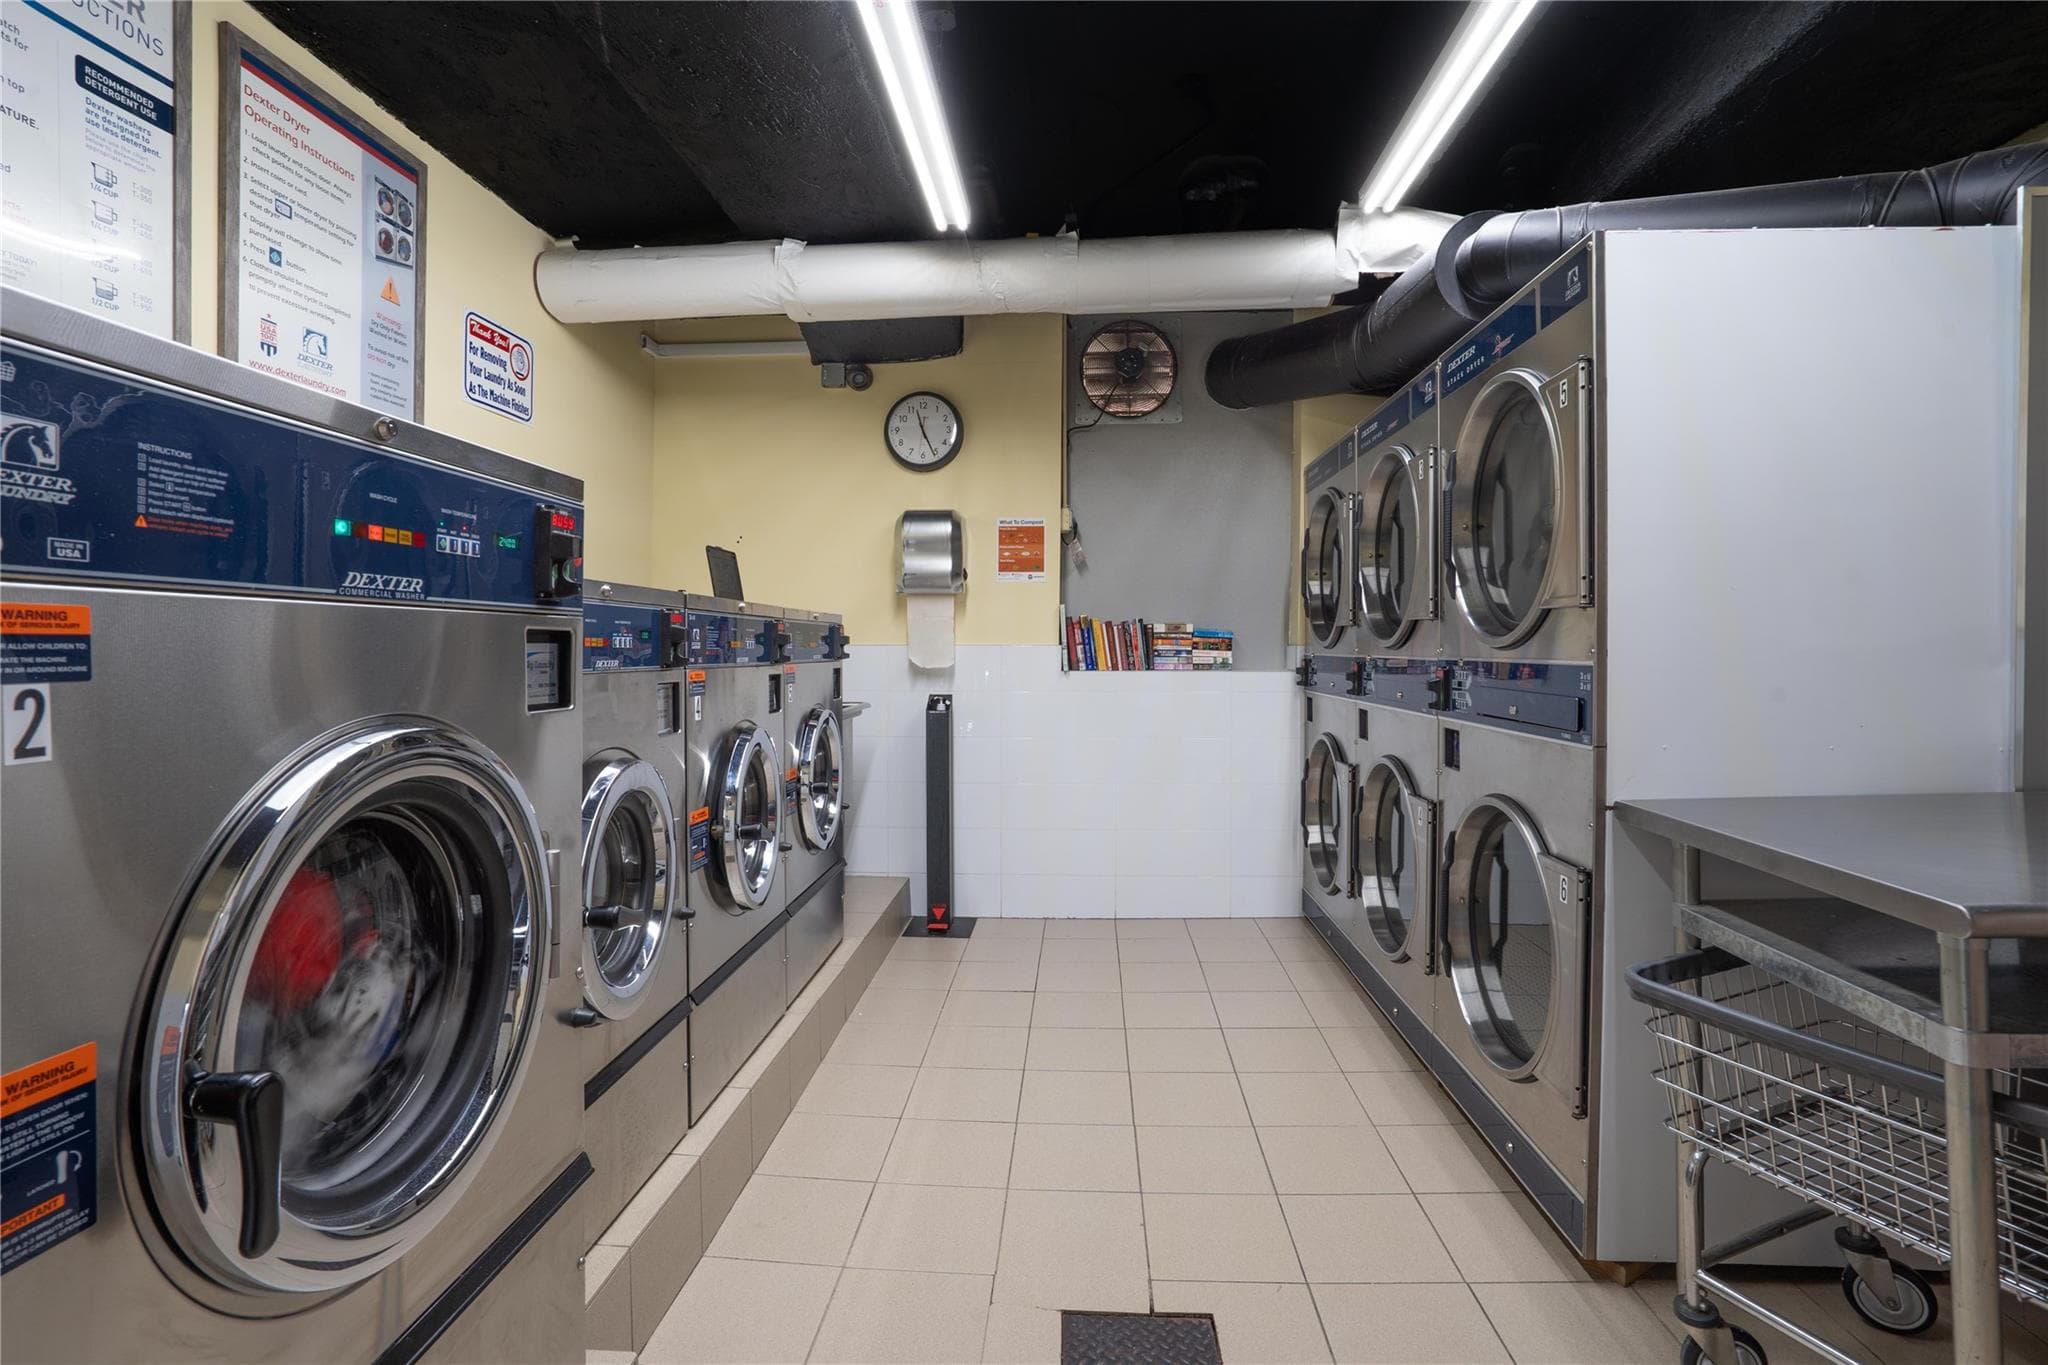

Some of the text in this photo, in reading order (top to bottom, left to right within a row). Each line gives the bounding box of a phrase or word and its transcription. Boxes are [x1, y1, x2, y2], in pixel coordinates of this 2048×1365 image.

[14, 37, 29, 52] for
[7, 78, 25, 94] top
[85, 65, 154, 109] RECOMMENDED
[85, 76, 158, 121] DETERGENT USE
[85, 96, 152, 137] Dexter washers
[244, 84, 311, 136] Dexter Dryer
[85, 108, 151, 145] are designed to
[85, 117, 162, 159] use less detergent.
[244, 104, 355, 182] Operating Instructions
[251, 133, 268, 147] Load
[268, 143, 291, 162] laundry
[292, 157, 304, 169] and
[304, 165, 318, 177] close
[250, 160, 294, 188] Insert coins or
[252, 146, 315, 188] check pockets for any
[90, 182, 119, 199] 1/4 CUP
[249, 199, 263, 210] that
[249, 188, 354, 247] desired temperature setting for
[250, 175, 357, 240] Select upper or lower dryer by pressing
[248, 227, 282, 247] purchased.
[250, 215, 330, 260] Display will change to show
[249, 242, 308, 274] Press button.
[248, 270, 318, 306] promptly after the cycle
[249, 258, 328, 299] Clothes should be removed
[104, 302, 120, 312] CUP
[248, 283, 308, 312] to prevent excessive
[260, 324, 276, 335] USA
[470, 321, 492, 339] Thank
[297, 353, 334, 372] DEXTER
[469, 341, 508, 373] For Removing
[1447, 345, 1476, 373] DEXTER
[1447, 355, 1485, 388] STACK DRYER
[248, 359, 347, 397] www.dexterlaundry.com
[469, 360, 526, 397] Your Laundry As Soon
[469, 380, 530, 417] As The Machine Finishes
[1561, 381, 1567, 405] 5
[935, 405, 939, 413] 1
[942, 414, 949, 422] 2
[895, 426, 900, 434] 9
[946, 425, 951, 433] 3
[137, 442, 193, 460] INSTRUCTIONS
[909, 447, 914, 455] 7
[54, 541, 75, 550] MADE
[56, 548, 82, 559] USA
[339, 587, 425, 600] COMMERCIAL WASHER
[342, 571, 423, 593] DEXTER
[1, 609, 68, 621] WARNING
[20, 621, 53, 629] SERIOUS
[7, 642, 36, 650] ALLOW
[13, 688, 46, 760] 2
[1561, 878, 1567, 900] 6
[4, 1061, 75, 1095] WARNING
[11, 1067, 89, 1102] OF SERIOUS INJURY
[4, 1102, 64, 1131] TO OPEN DOOR
[11, 1111, 70, 1141] STILL TURNING
[26, 1111, 85, 1143] IN THE WINDOW
[6, 1123, 75, 1159] LIGHT IS STILL ON
[35, 1207, 90, 1241] MINUTE DELAY
[4, 1215, 89, 1265] DOOR CAN BE OPENED
